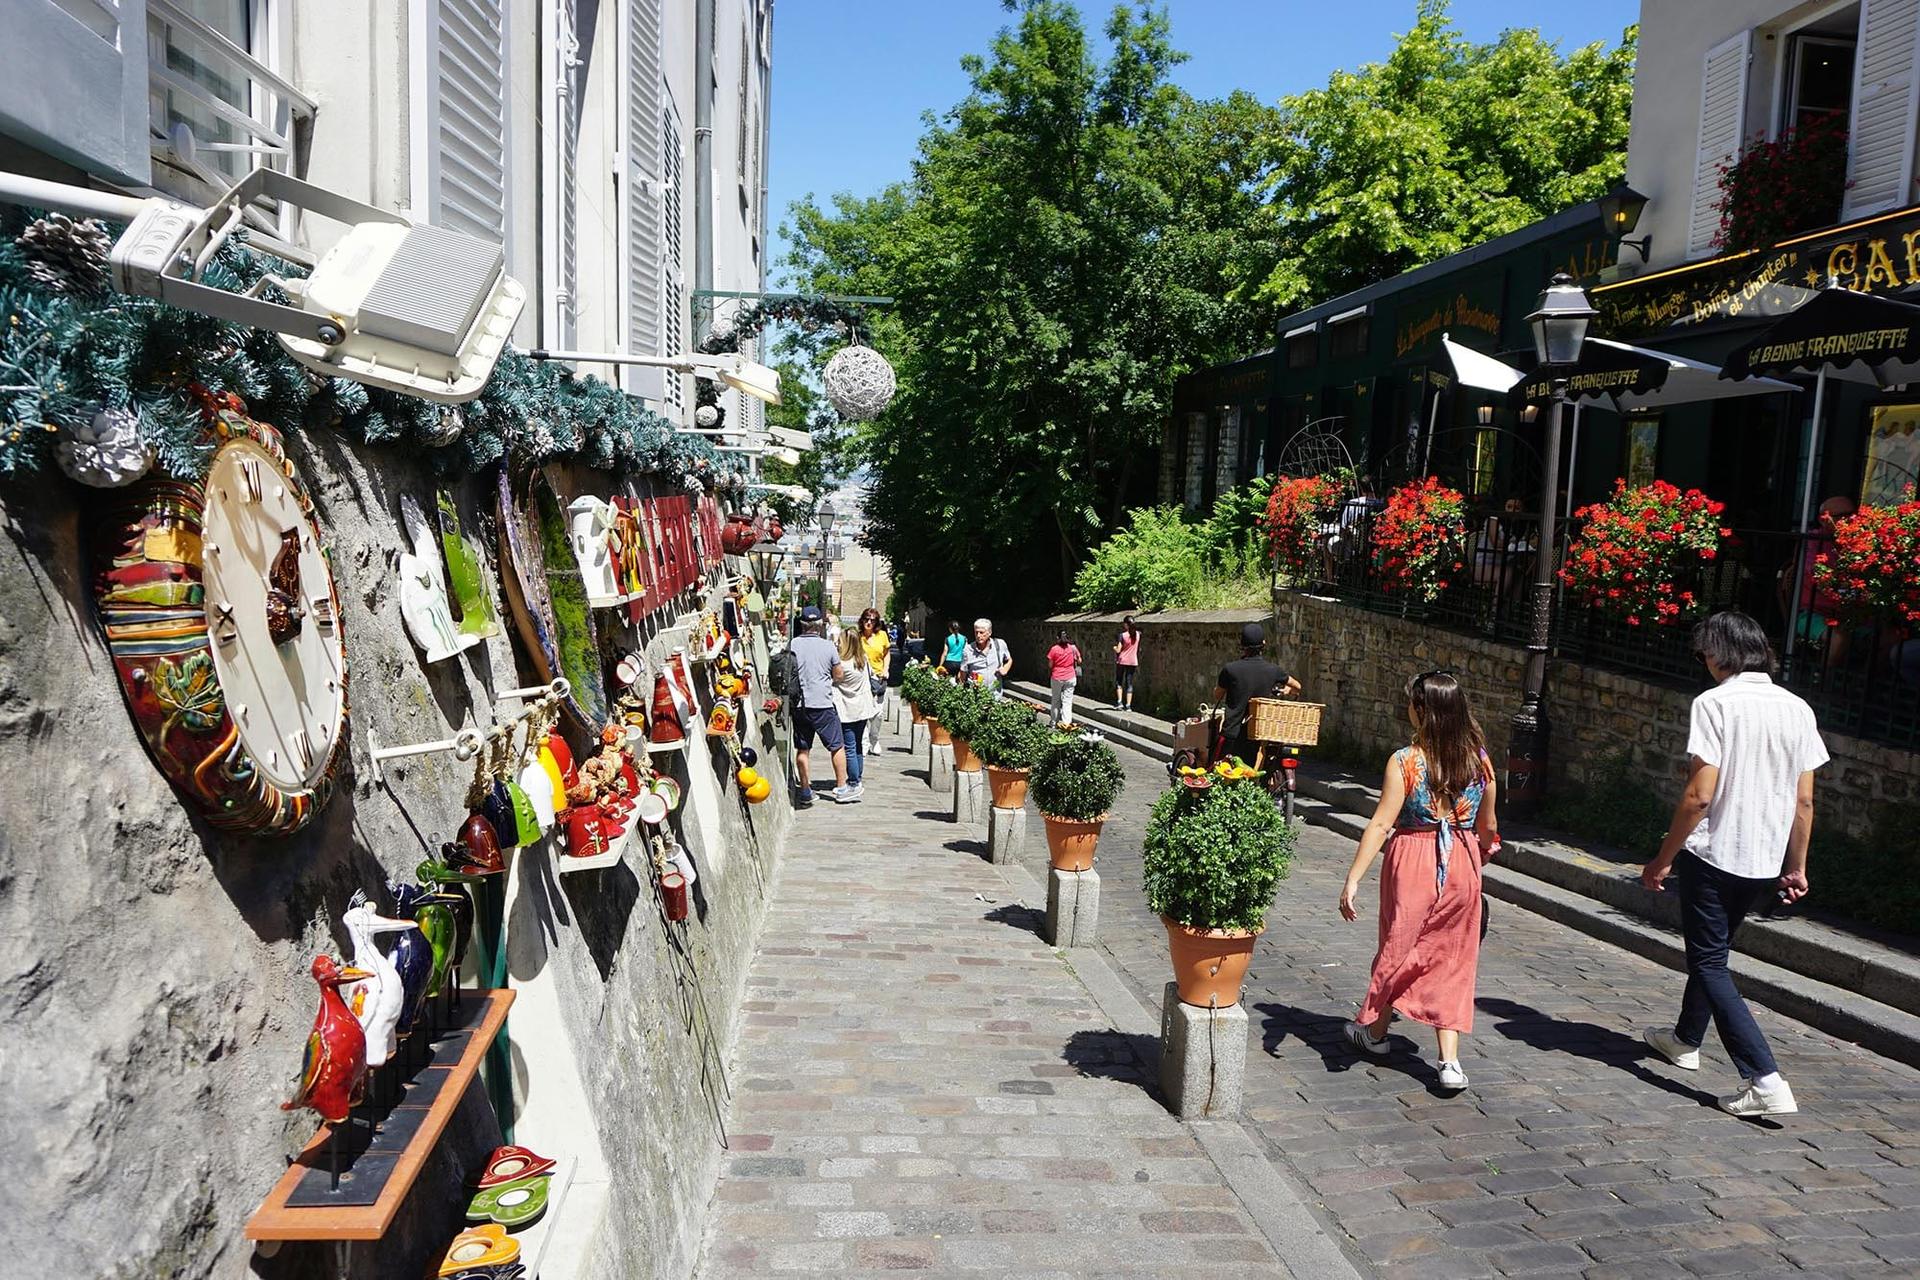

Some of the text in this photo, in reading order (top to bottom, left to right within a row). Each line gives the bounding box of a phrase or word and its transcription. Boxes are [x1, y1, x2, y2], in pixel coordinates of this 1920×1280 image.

[1691, 288, 1729, 323] Boire
[1729, 296, 1743, 316] et
[1749, 327, 1910, 367] LA BONNE FRANQUETTE
[1570, 369, 1640, 391] FRANQUETTE
